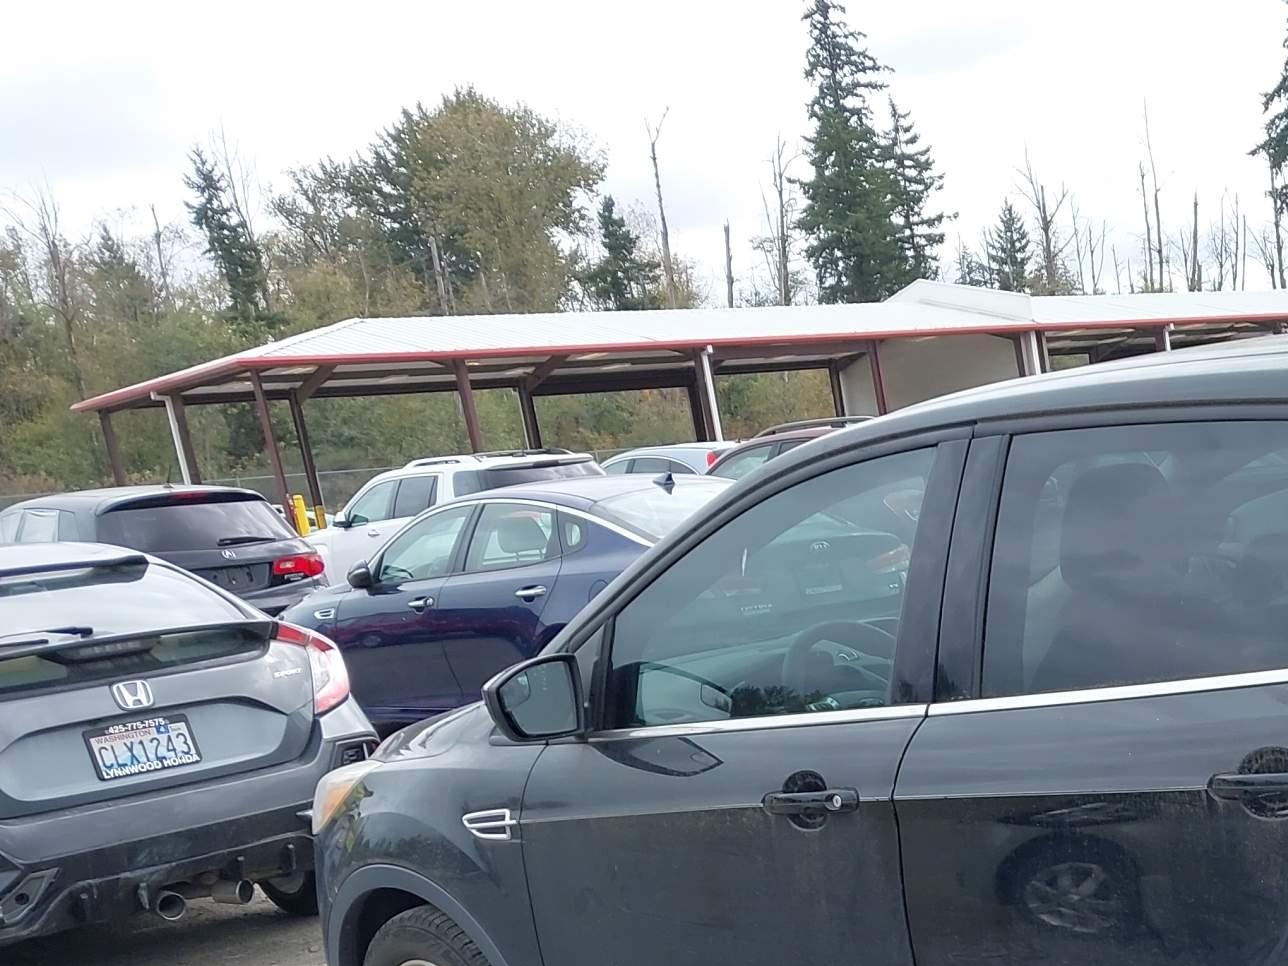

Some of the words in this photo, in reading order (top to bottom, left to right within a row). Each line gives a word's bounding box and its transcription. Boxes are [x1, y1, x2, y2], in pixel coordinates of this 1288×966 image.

[95, 728, 152, 745] WASHINGTON
[98, 732, 192, 770] CLX1243
[102, 760, 162, 779] LYNNWOOD
[163, 753, 201, 769] HONDA
